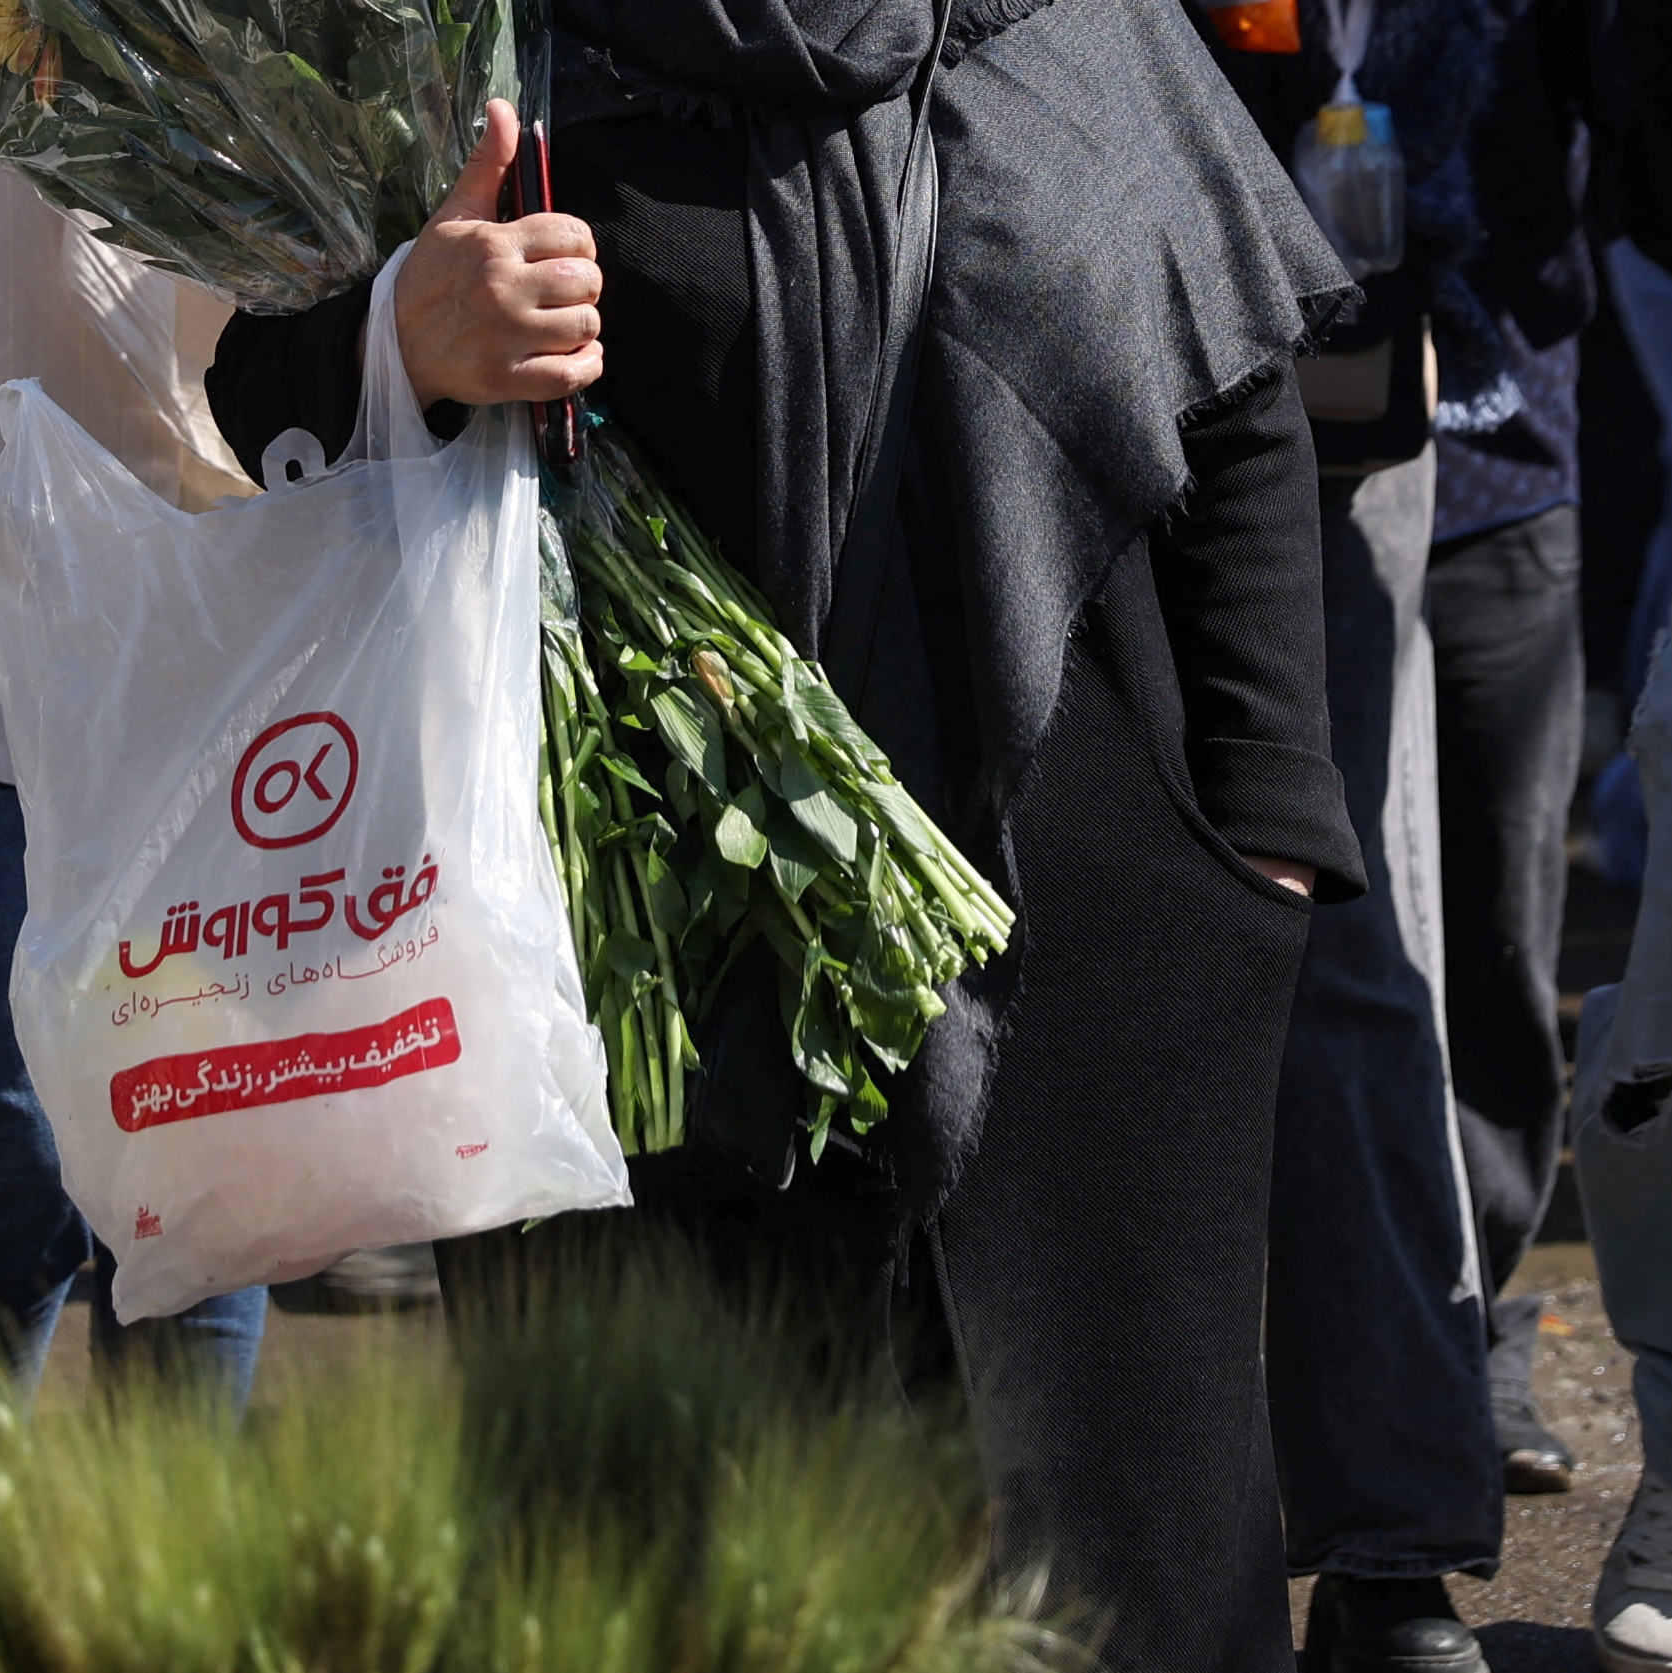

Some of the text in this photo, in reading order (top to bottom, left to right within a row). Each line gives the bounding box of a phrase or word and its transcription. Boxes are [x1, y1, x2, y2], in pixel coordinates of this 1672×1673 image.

[253, 742, 334, 814] OK
[118, 853, 440, 979] فق کوروش
[348, 1016, 443, 1074] تخفیف
[129, 1080, 174, 1120] بهتر
[175, 1058, 254, 1107] زندگی
